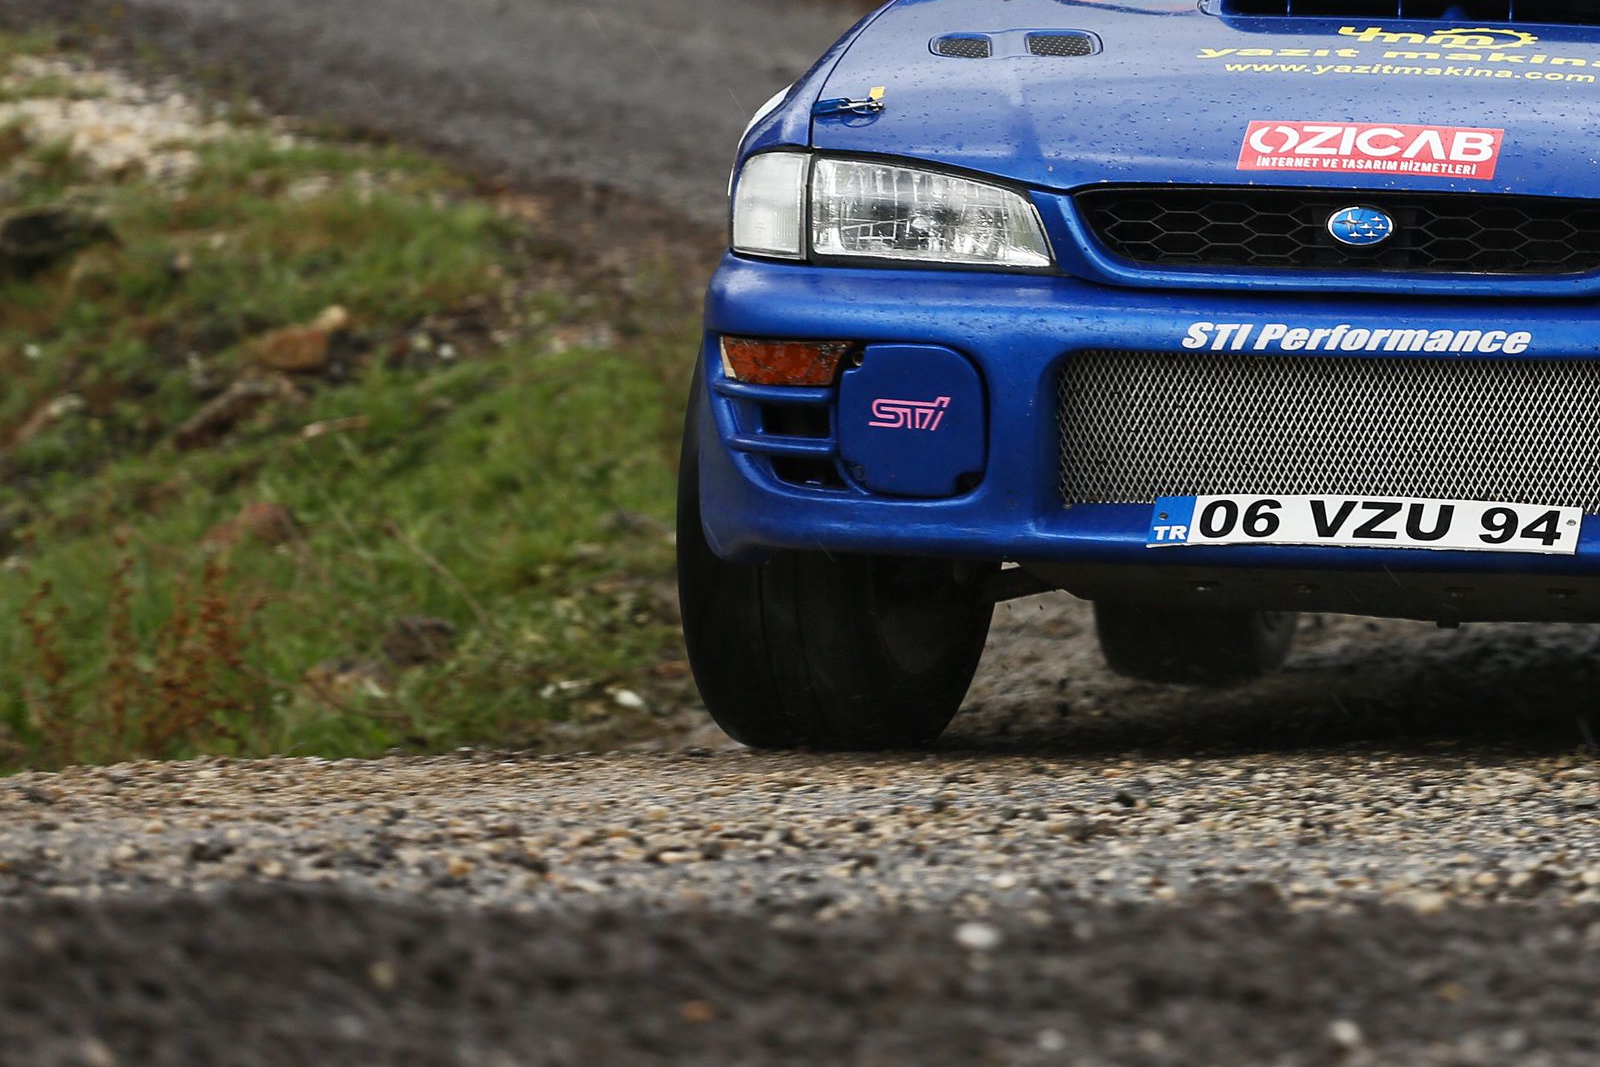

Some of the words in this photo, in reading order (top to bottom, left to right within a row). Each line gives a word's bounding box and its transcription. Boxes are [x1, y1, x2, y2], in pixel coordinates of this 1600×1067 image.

[1224, 63, 1597, 83] www.yazitmakina.com
[1322, 158, 1339, 169] VE
[1341, 158, 1398, 171] TASARIM
[1181, 321, 1252, 352] STI
[1253, 323, 1533, 355] Performance
[1153, 525, 1187, 541] TR
[1199, 498, 1282, 539] 06
[1309, 500, 1456, 541] VZU
[1479, 507, 1562, 546] 94
